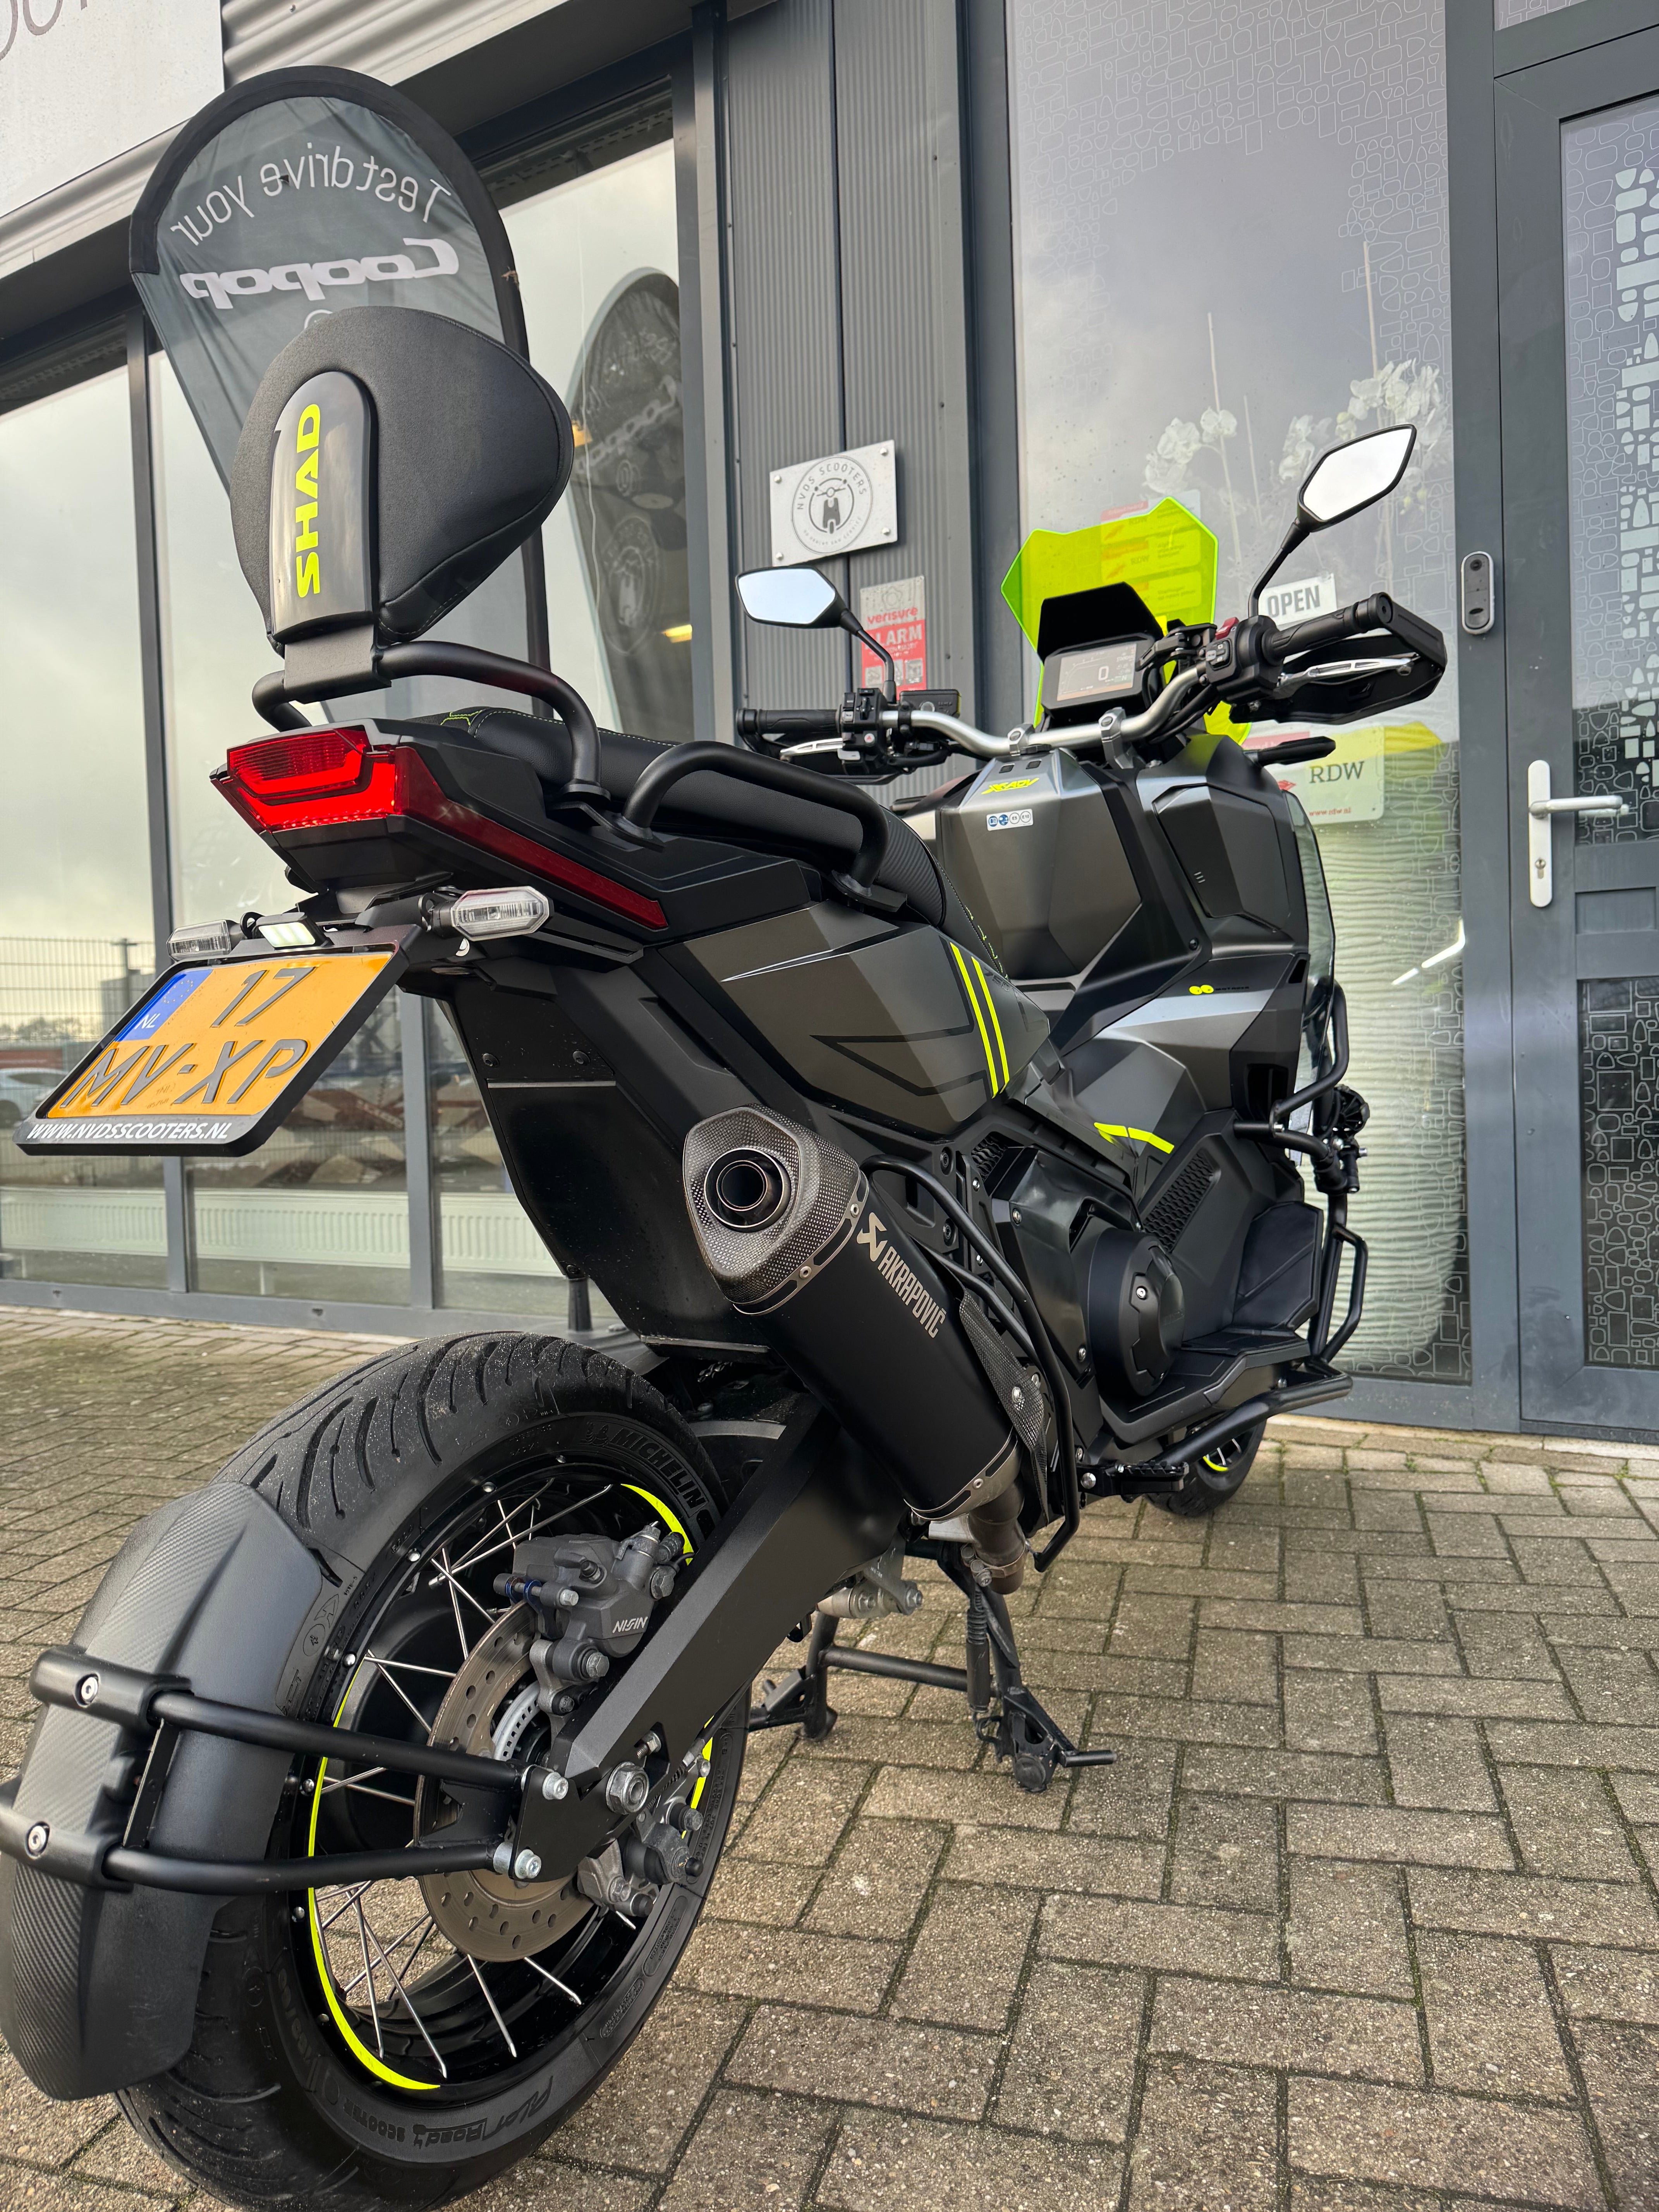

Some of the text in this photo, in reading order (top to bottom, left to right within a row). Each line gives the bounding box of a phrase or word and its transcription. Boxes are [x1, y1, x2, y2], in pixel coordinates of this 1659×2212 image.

[797, 462, 867, 510] NVDS SCOOTERS
[295, 404, 321, 598] SHAD
[1267, 584, 1321, 618] OPEN
[867, 607, 918, 624] verisure
[1098, 665, 1109, 681] 0
[1309, 761, 1365, 784] RDW
[1309, 807, 1352, 816] www.rdw.nl
[211, 966, 317, 1028] 17
[134, 1013, 161, 1029] NL
[59, 1038, 311, 1109] MV-XP
[26, 1122, 232, 1140] WWW.NVDSSCOOTERS.NL
[610, 1427, 709, 1510] MICHELIN
[612, 1616, 648, 1633] NISSIN
[343, 2097, 405, 2142] SCOOTER
